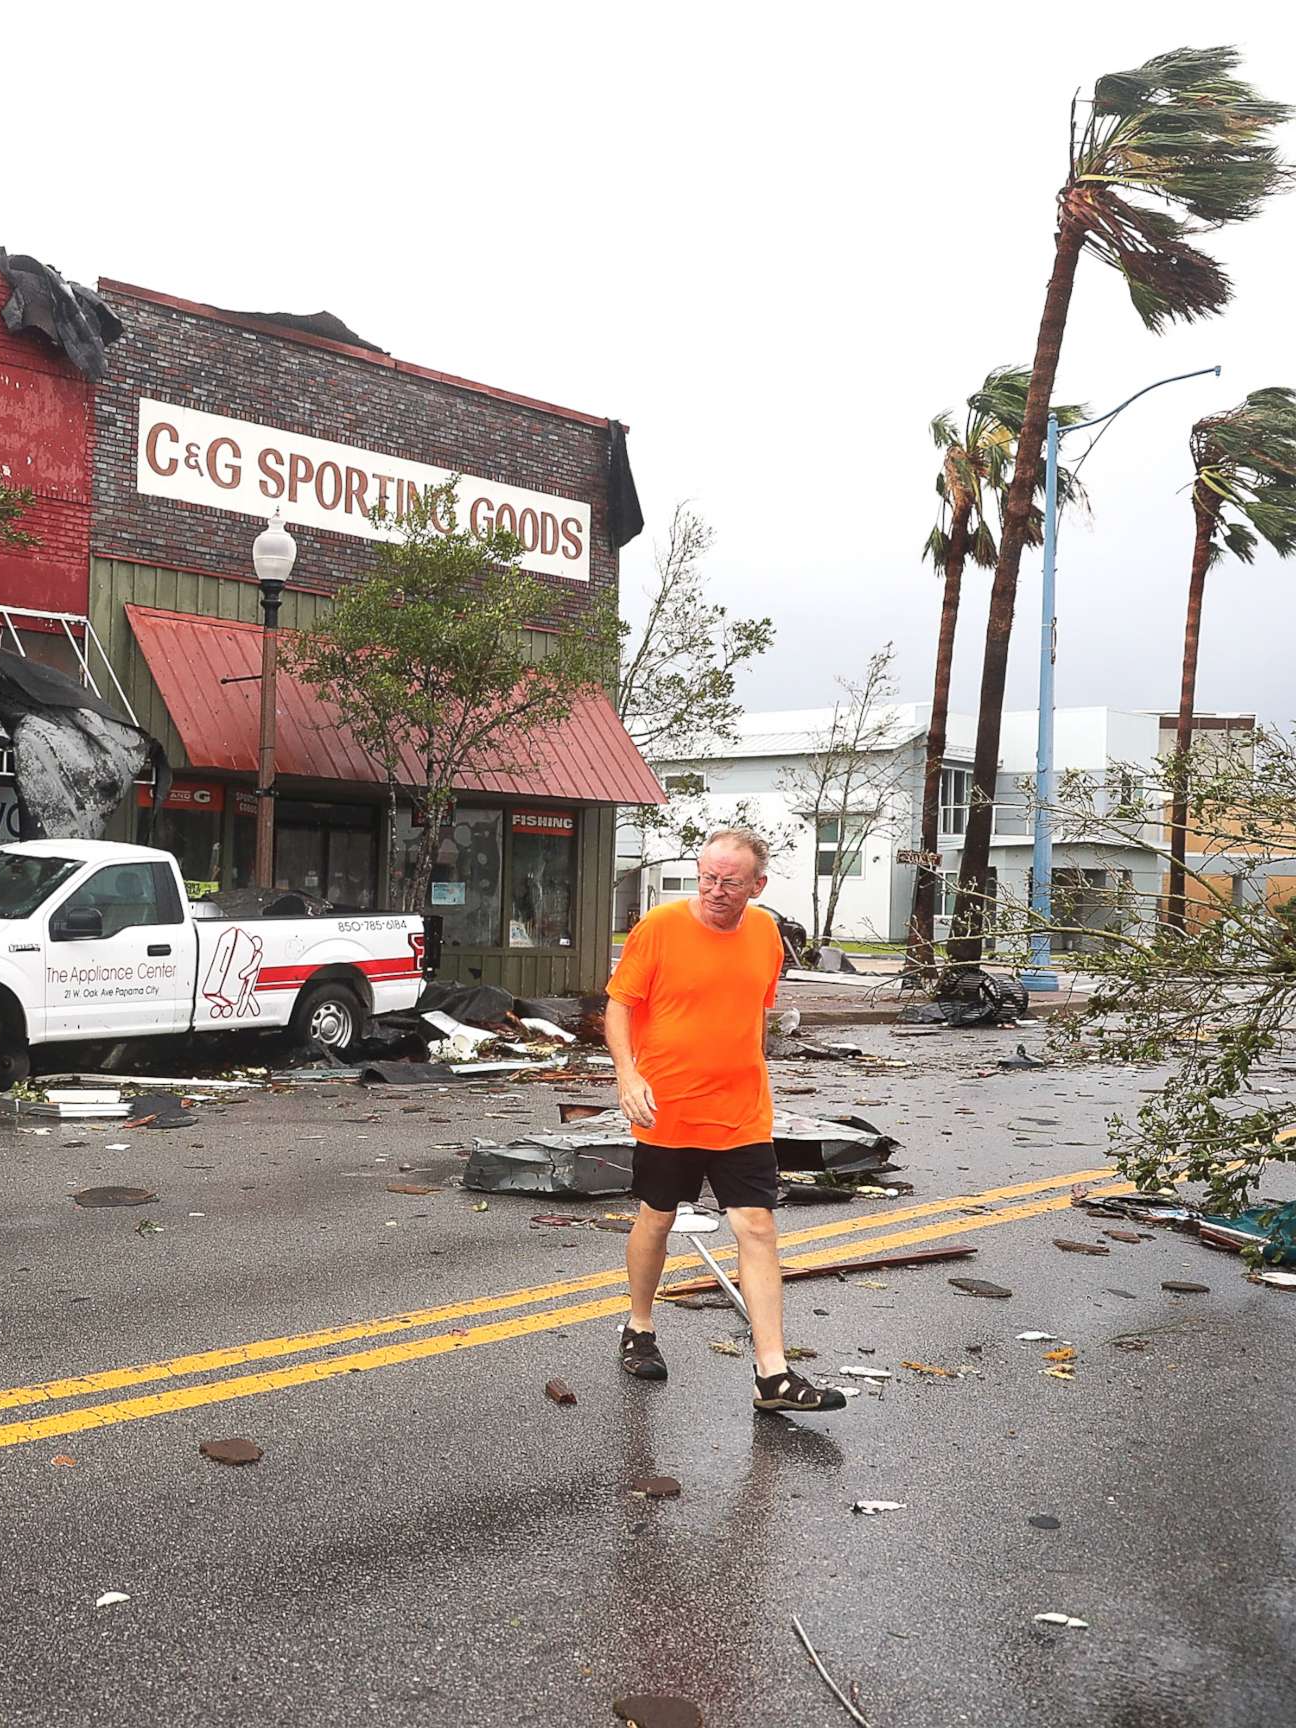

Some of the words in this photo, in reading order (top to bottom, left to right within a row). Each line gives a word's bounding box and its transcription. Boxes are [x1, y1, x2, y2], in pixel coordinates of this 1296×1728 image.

[145, 422, 242, 489] C&G
[469, 497, 584, 560] GOODS
[193, 790, 211, 803] G
[46, 967, 68, 983] The
[69, 965, 134, 985] Appliance
[137, 962, 176, 979] Center
[83, 988, 98, 998] Oak
[101, 988, 114, 997] Ave
[115, 987, 144, 997] Panama
[145, 985, 160, 996] City
